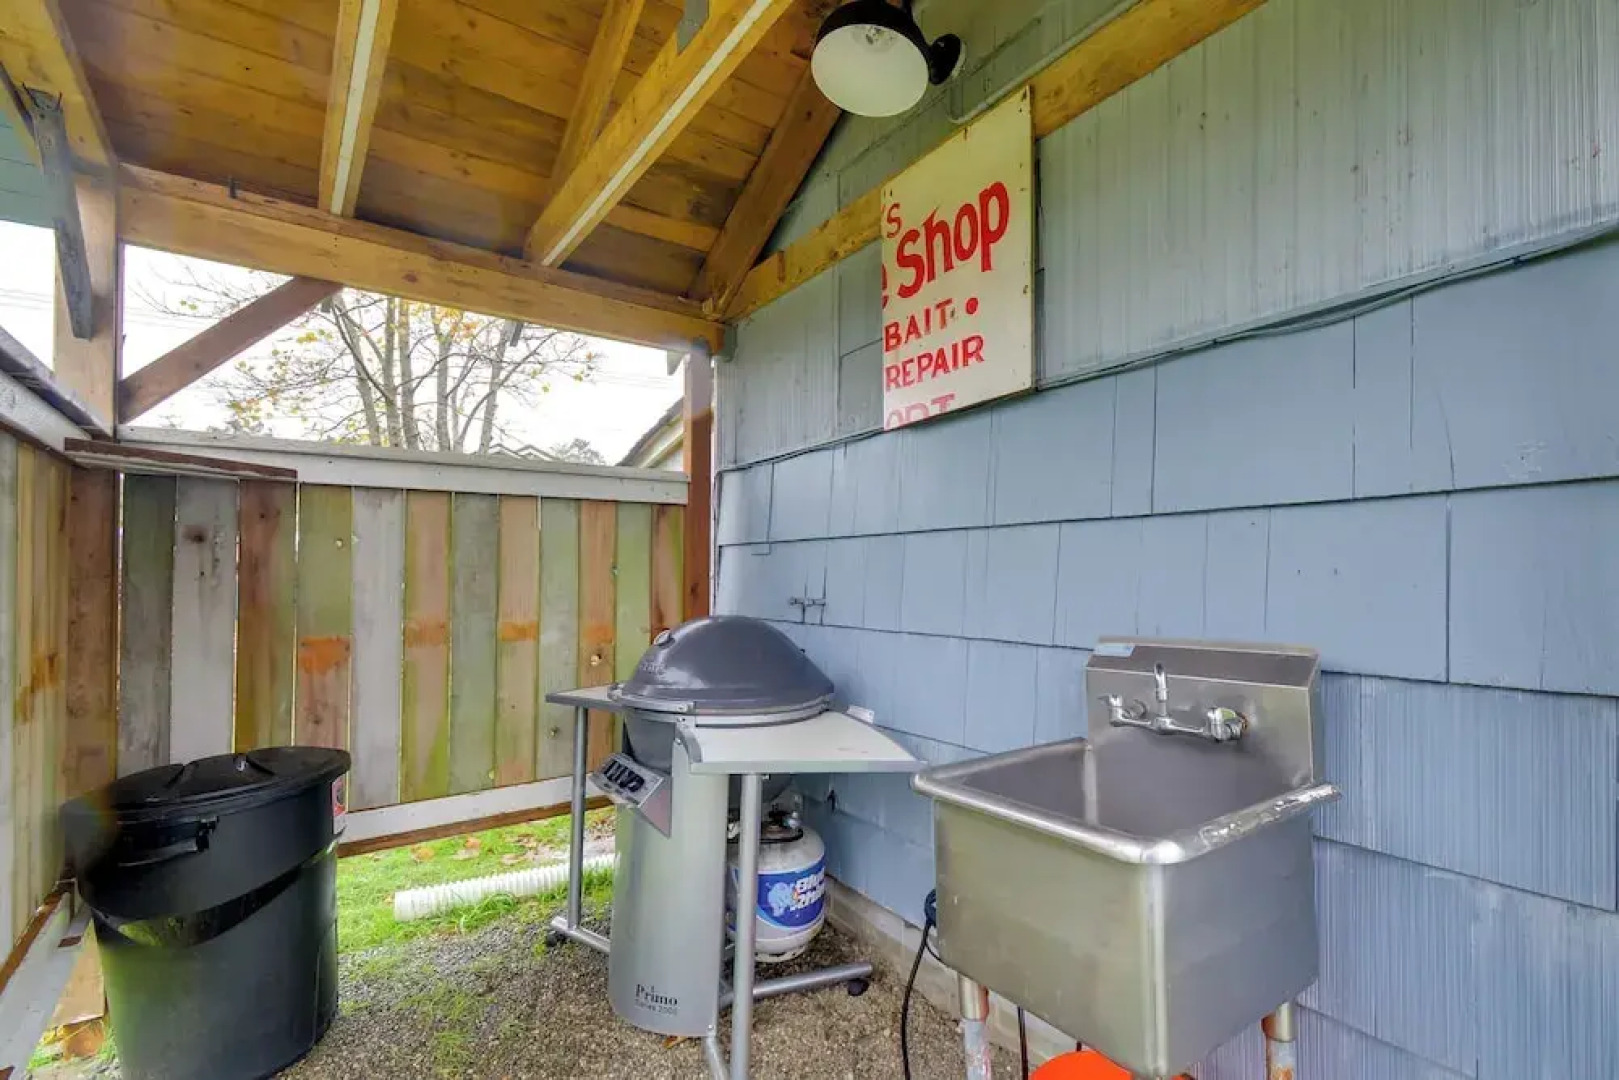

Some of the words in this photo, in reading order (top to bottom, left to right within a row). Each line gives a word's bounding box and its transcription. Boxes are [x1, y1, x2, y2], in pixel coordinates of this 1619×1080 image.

[896, 181, 1010, 299] Shop
[885, 299, 952, 351] BAIT
[885, 335, 984, 390] REPAIR
[635, 983, 678, 1005] Primo
